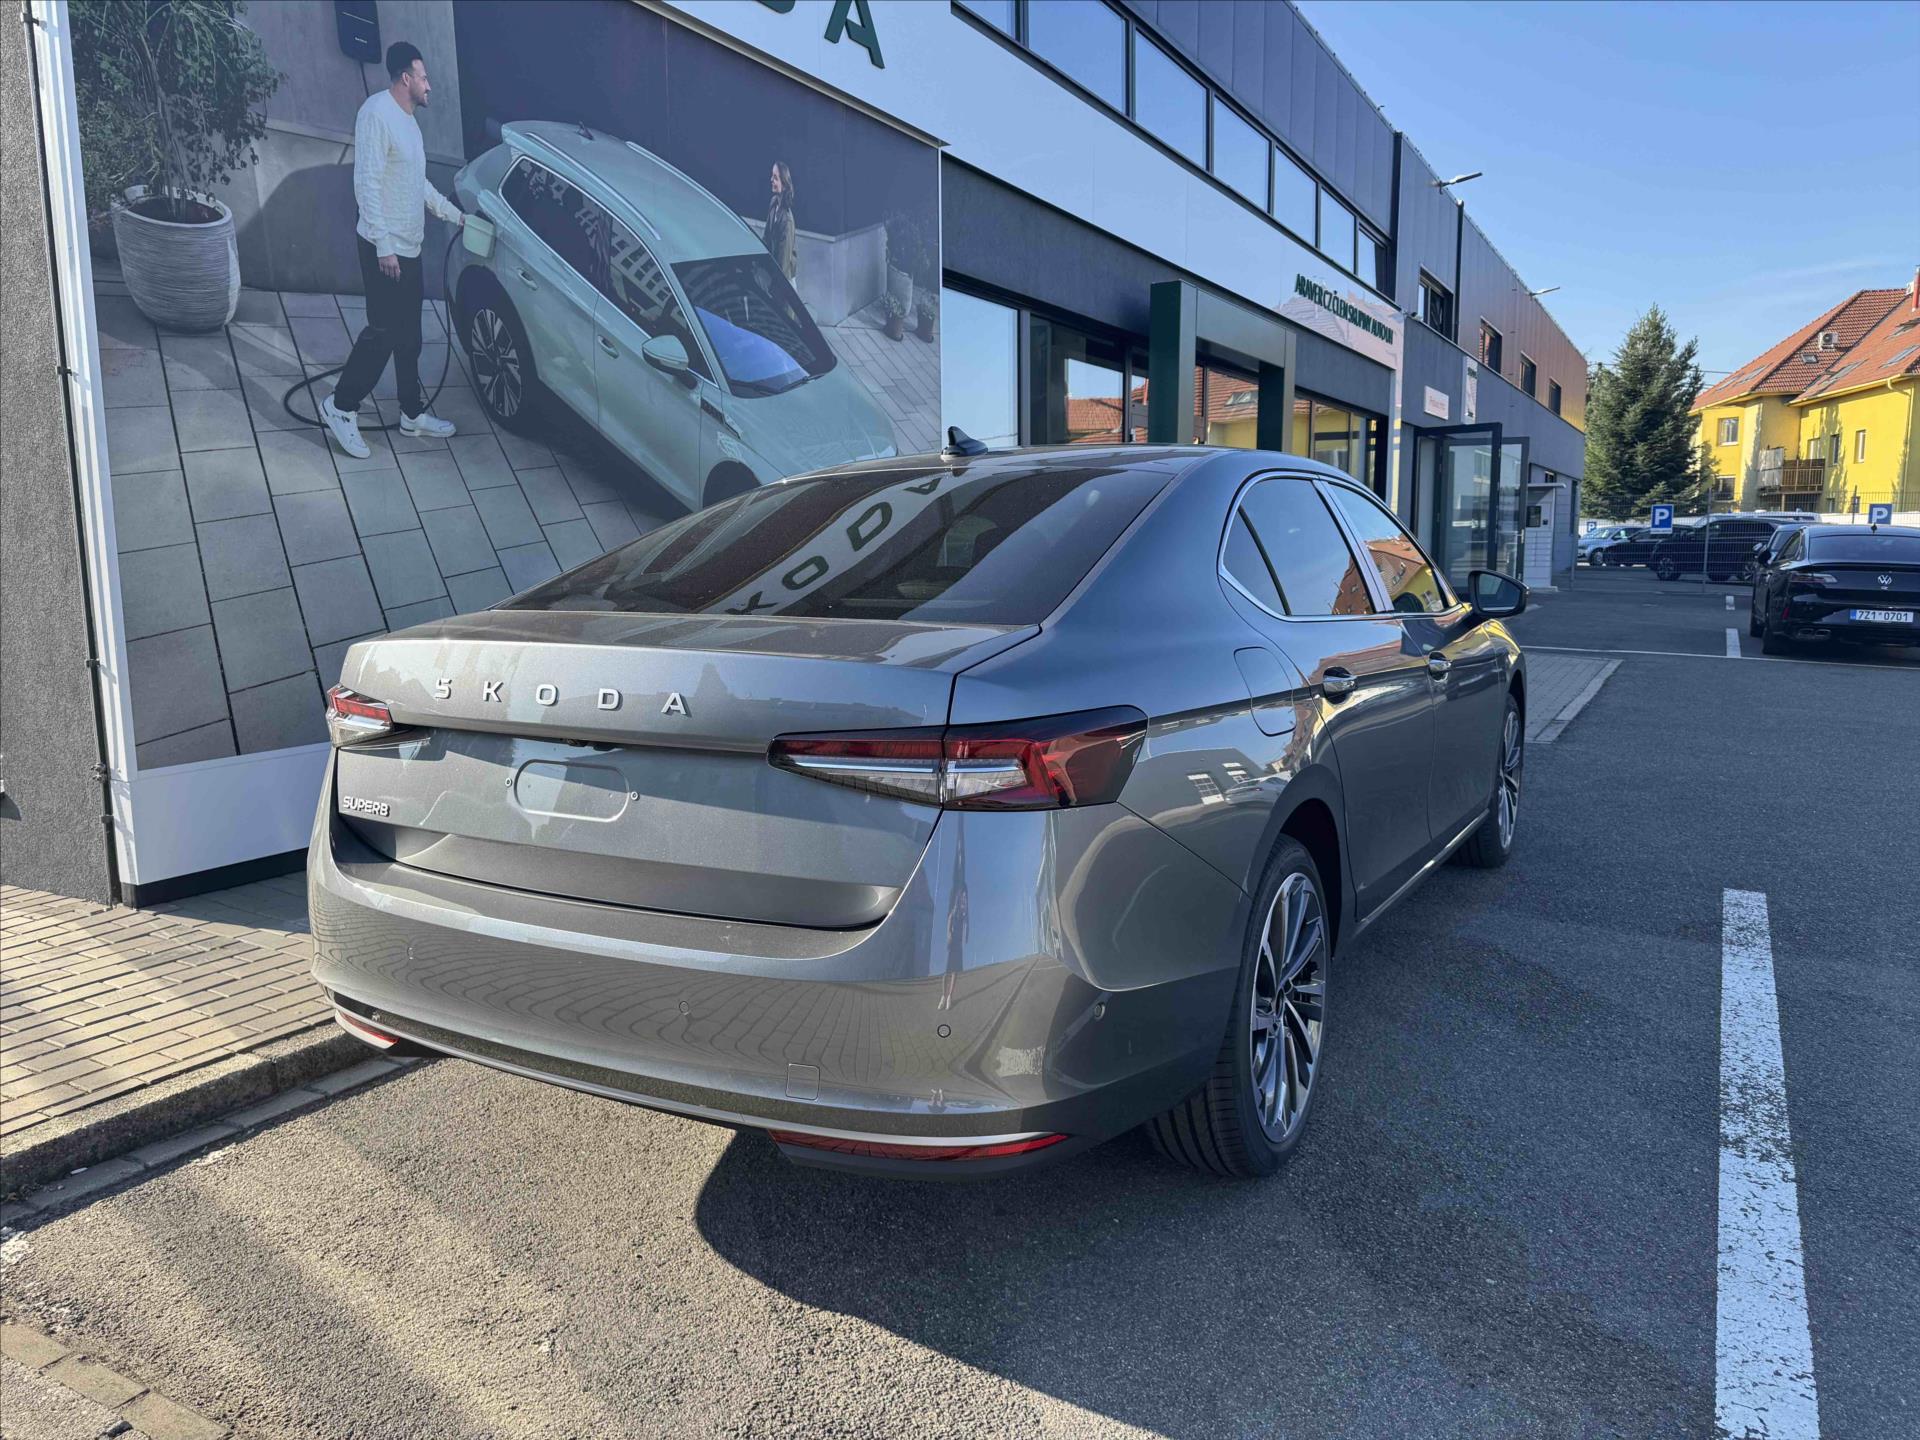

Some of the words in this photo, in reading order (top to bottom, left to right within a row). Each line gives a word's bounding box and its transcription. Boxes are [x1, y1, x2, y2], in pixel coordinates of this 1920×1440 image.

[1294, 273, 1323, 306] ARAVER
[1655, 508, 1669, 525] P
[1872, 507, 1888, 523] P
[1858, 610, 1876, 620] 7Z1
[1883, 612, 1908, 622] 0701
[343, 796, 390, 817] SUPERB
